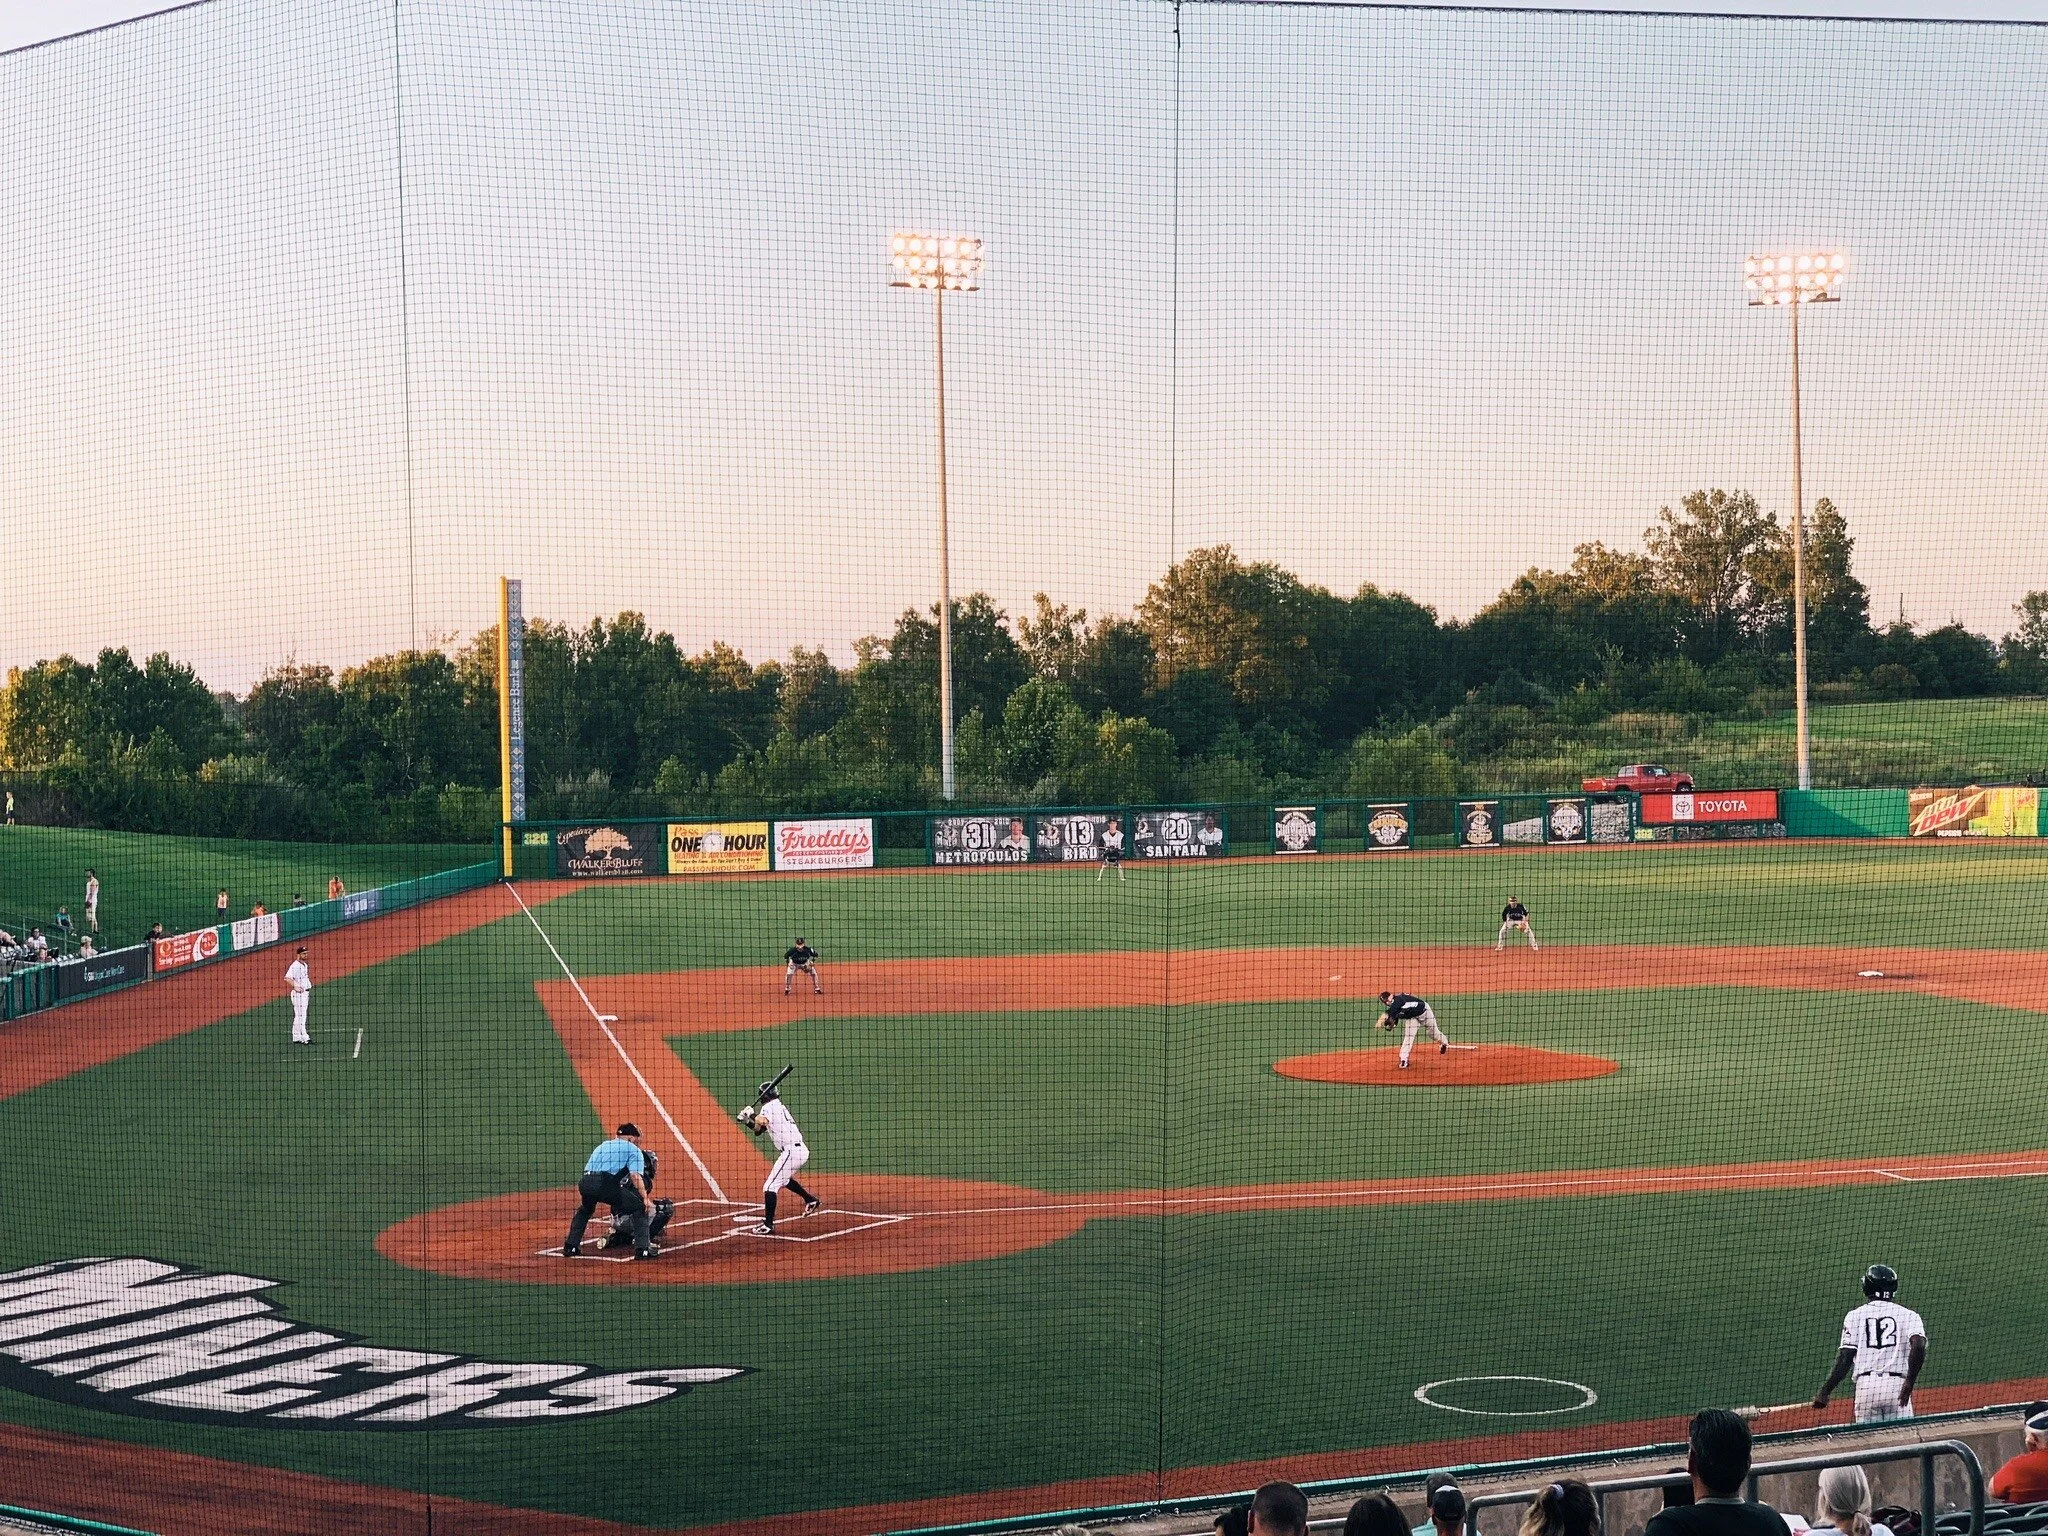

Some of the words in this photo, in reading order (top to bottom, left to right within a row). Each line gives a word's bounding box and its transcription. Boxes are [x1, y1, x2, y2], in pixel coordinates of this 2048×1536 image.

[510, 670, 520, 696] Bank
[511, 698, 523, 740] Legence
[1698, 800, 1748, 812] TOYOTA
[1920, 800, 1969, 831] DEW
[523, 832, 549, 846] 320
[674, 827, 699, 837] Pass
[777, 825, 870, 853] Freddy's
[966, 822, 991, 849] 31
[1069, 820, 1091, 845] 13
[1165, 818, 1189, 840] 20
[671, 836, 702, 853] ONE
[723, 834, 766, 852] HOUR
[1063, 846, 1098, 860] BIRD
[1146, 844, 1207, 857] SANTANA
[786, 856, 863, 865] STEAKBURGERS
[935, 851, 1028, 863] METROPOULOS
[0, 1257, 746, 1422] MINERS
[1865, 1316, 1897, 1349] 12
